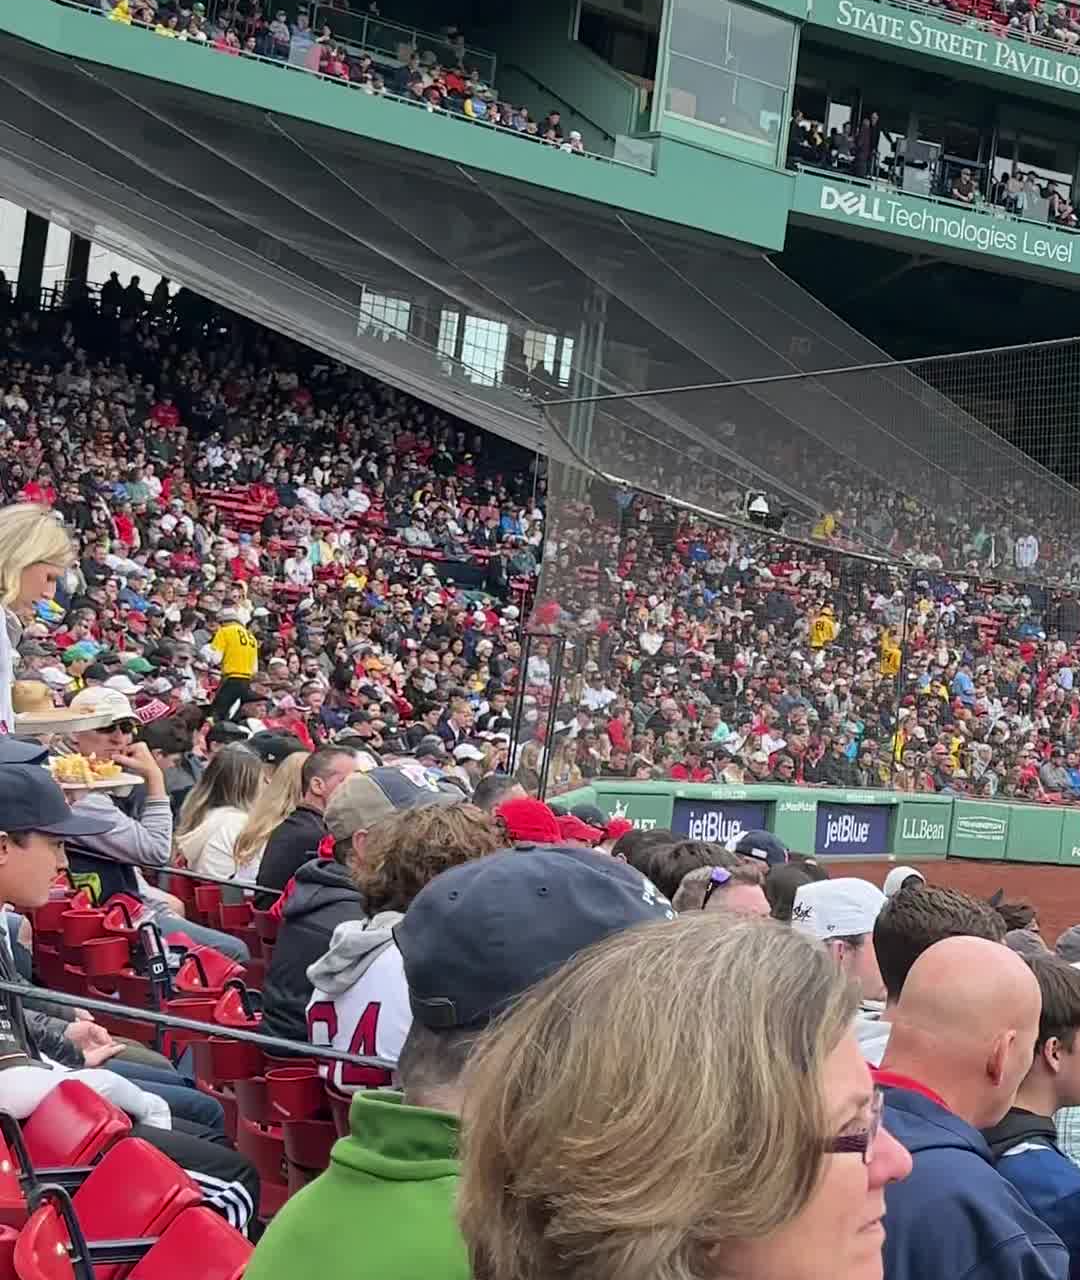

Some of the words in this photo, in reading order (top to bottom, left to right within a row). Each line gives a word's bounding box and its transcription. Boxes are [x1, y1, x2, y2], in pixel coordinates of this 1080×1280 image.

[837, 0, 905, 40] STATE
[820, 185, 886, 222] DELL
[887, 200, 1017, 251] Technologies
[1022, 231, 1074, 263] Level
[824, 814, 870, 848] jetBlue
